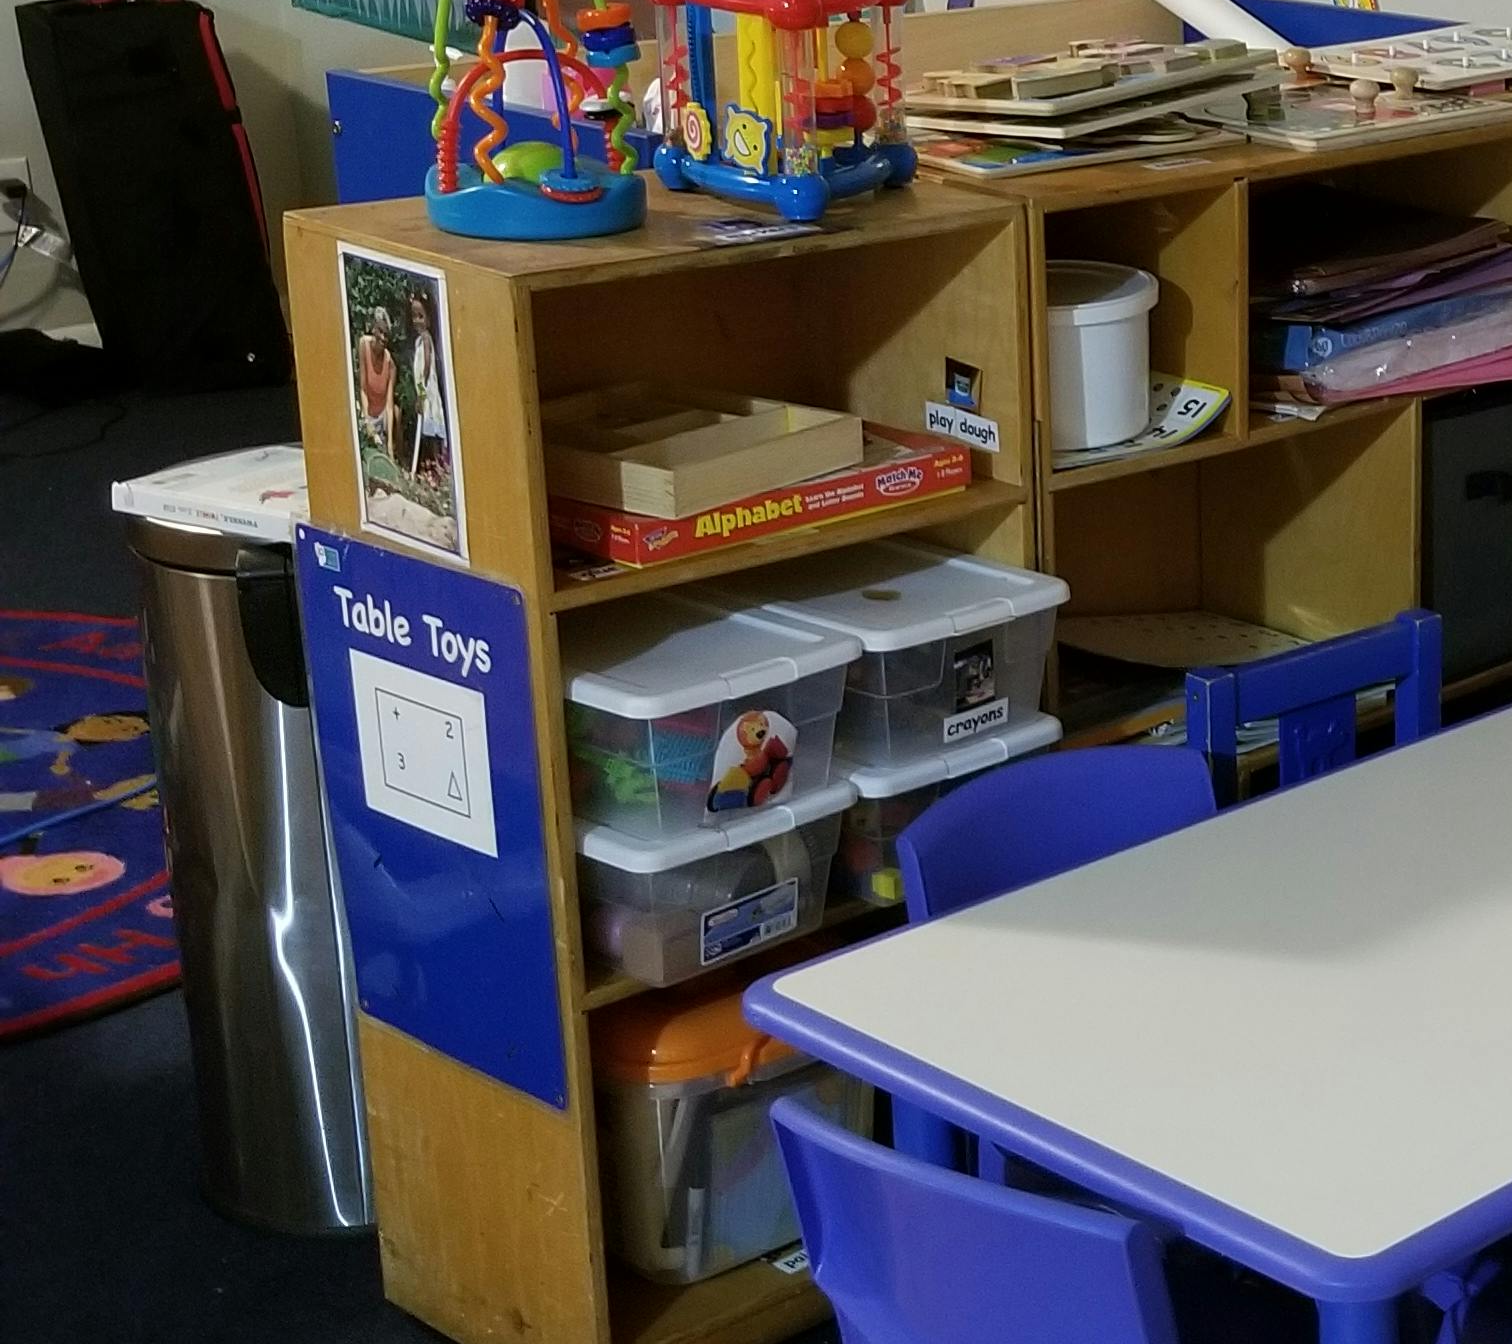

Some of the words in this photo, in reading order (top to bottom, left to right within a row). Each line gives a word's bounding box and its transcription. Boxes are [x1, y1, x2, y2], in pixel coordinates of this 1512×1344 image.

[929, 409, 954, 434] play
[960, 417, 996, 444] dough
[877, 470, 906, 487] Match
[907, 467, 923, 480] Me
[694, 493, 803, 539] Alphabet
[332, 585, 412, 647] Table
[422, 613, 492, 678] Toys
[444, 720, 455, 740] 2
[947, 705, 1005, 736] crayons
[397, 752, 406, 770] 3
